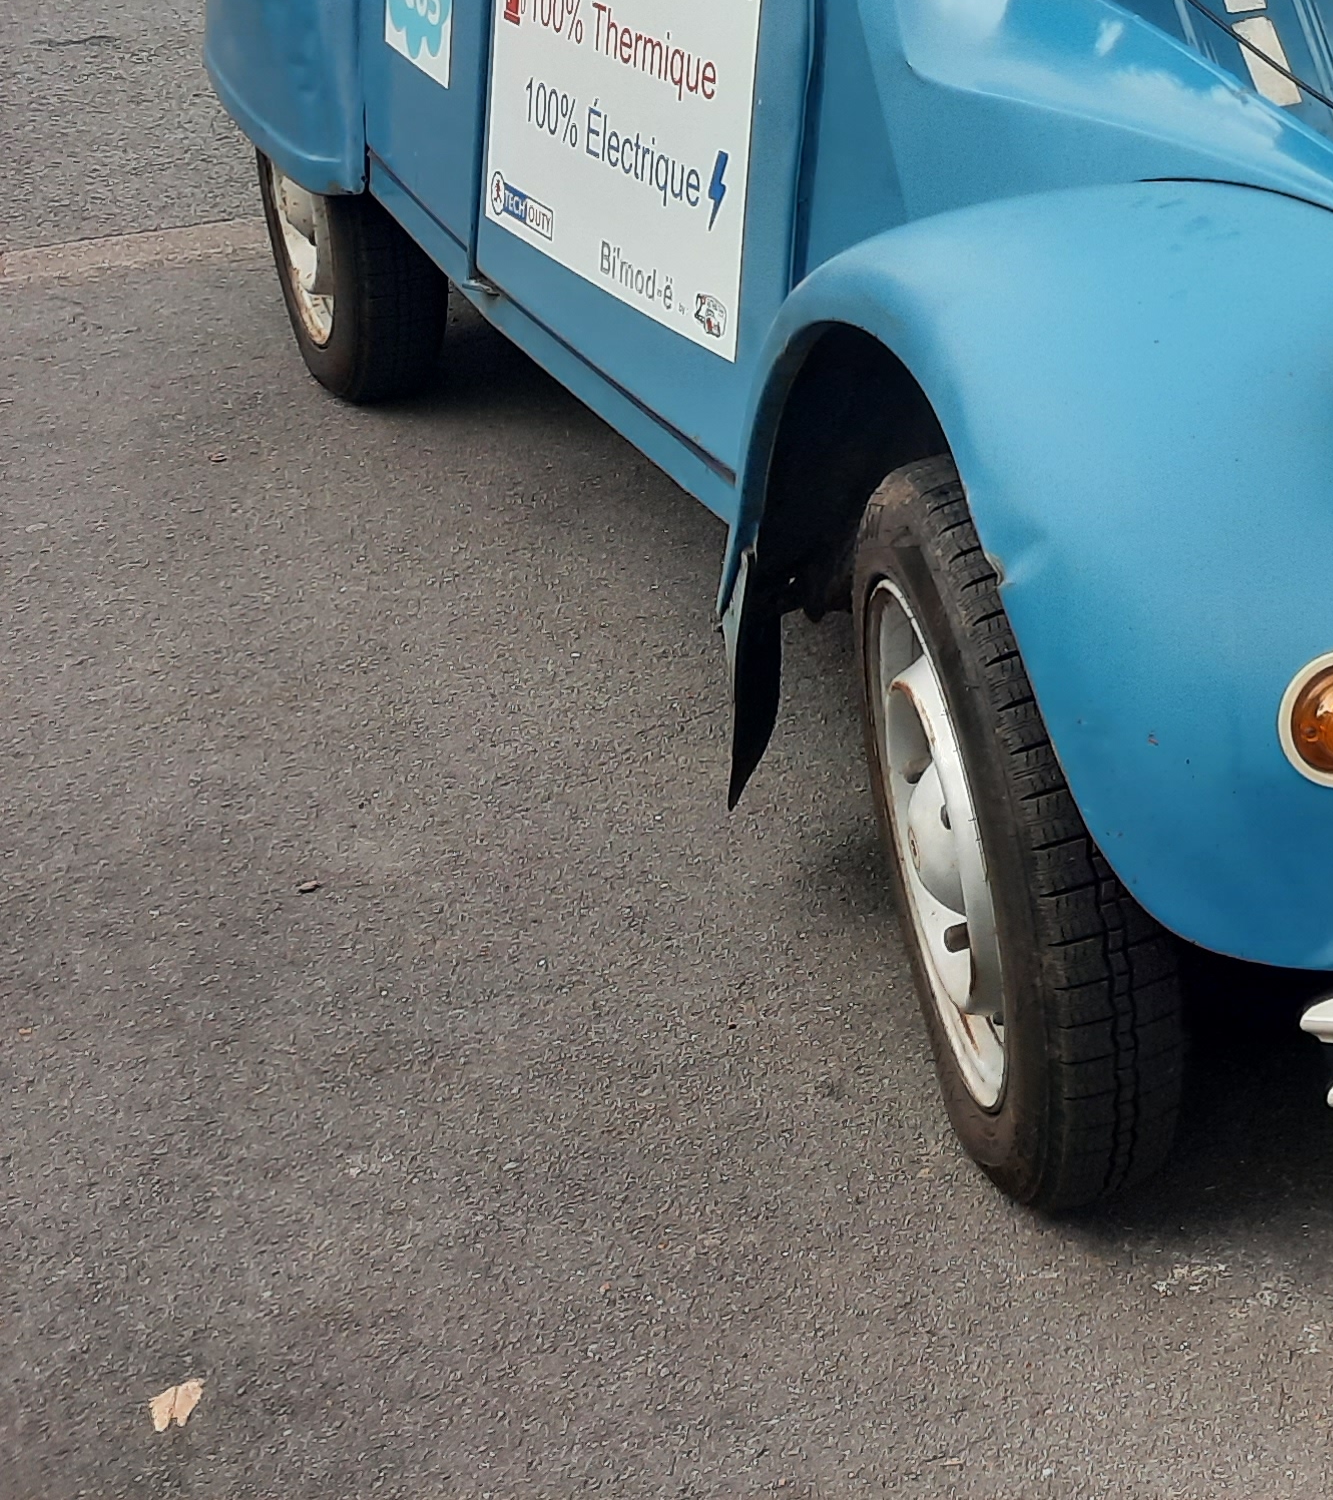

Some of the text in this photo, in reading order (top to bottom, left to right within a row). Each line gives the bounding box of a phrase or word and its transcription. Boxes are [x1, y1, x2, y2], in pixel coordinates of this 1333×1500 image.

[592, 1, 717, 102] Thermique
[525, 76, 701, 207] 100% Électrique
